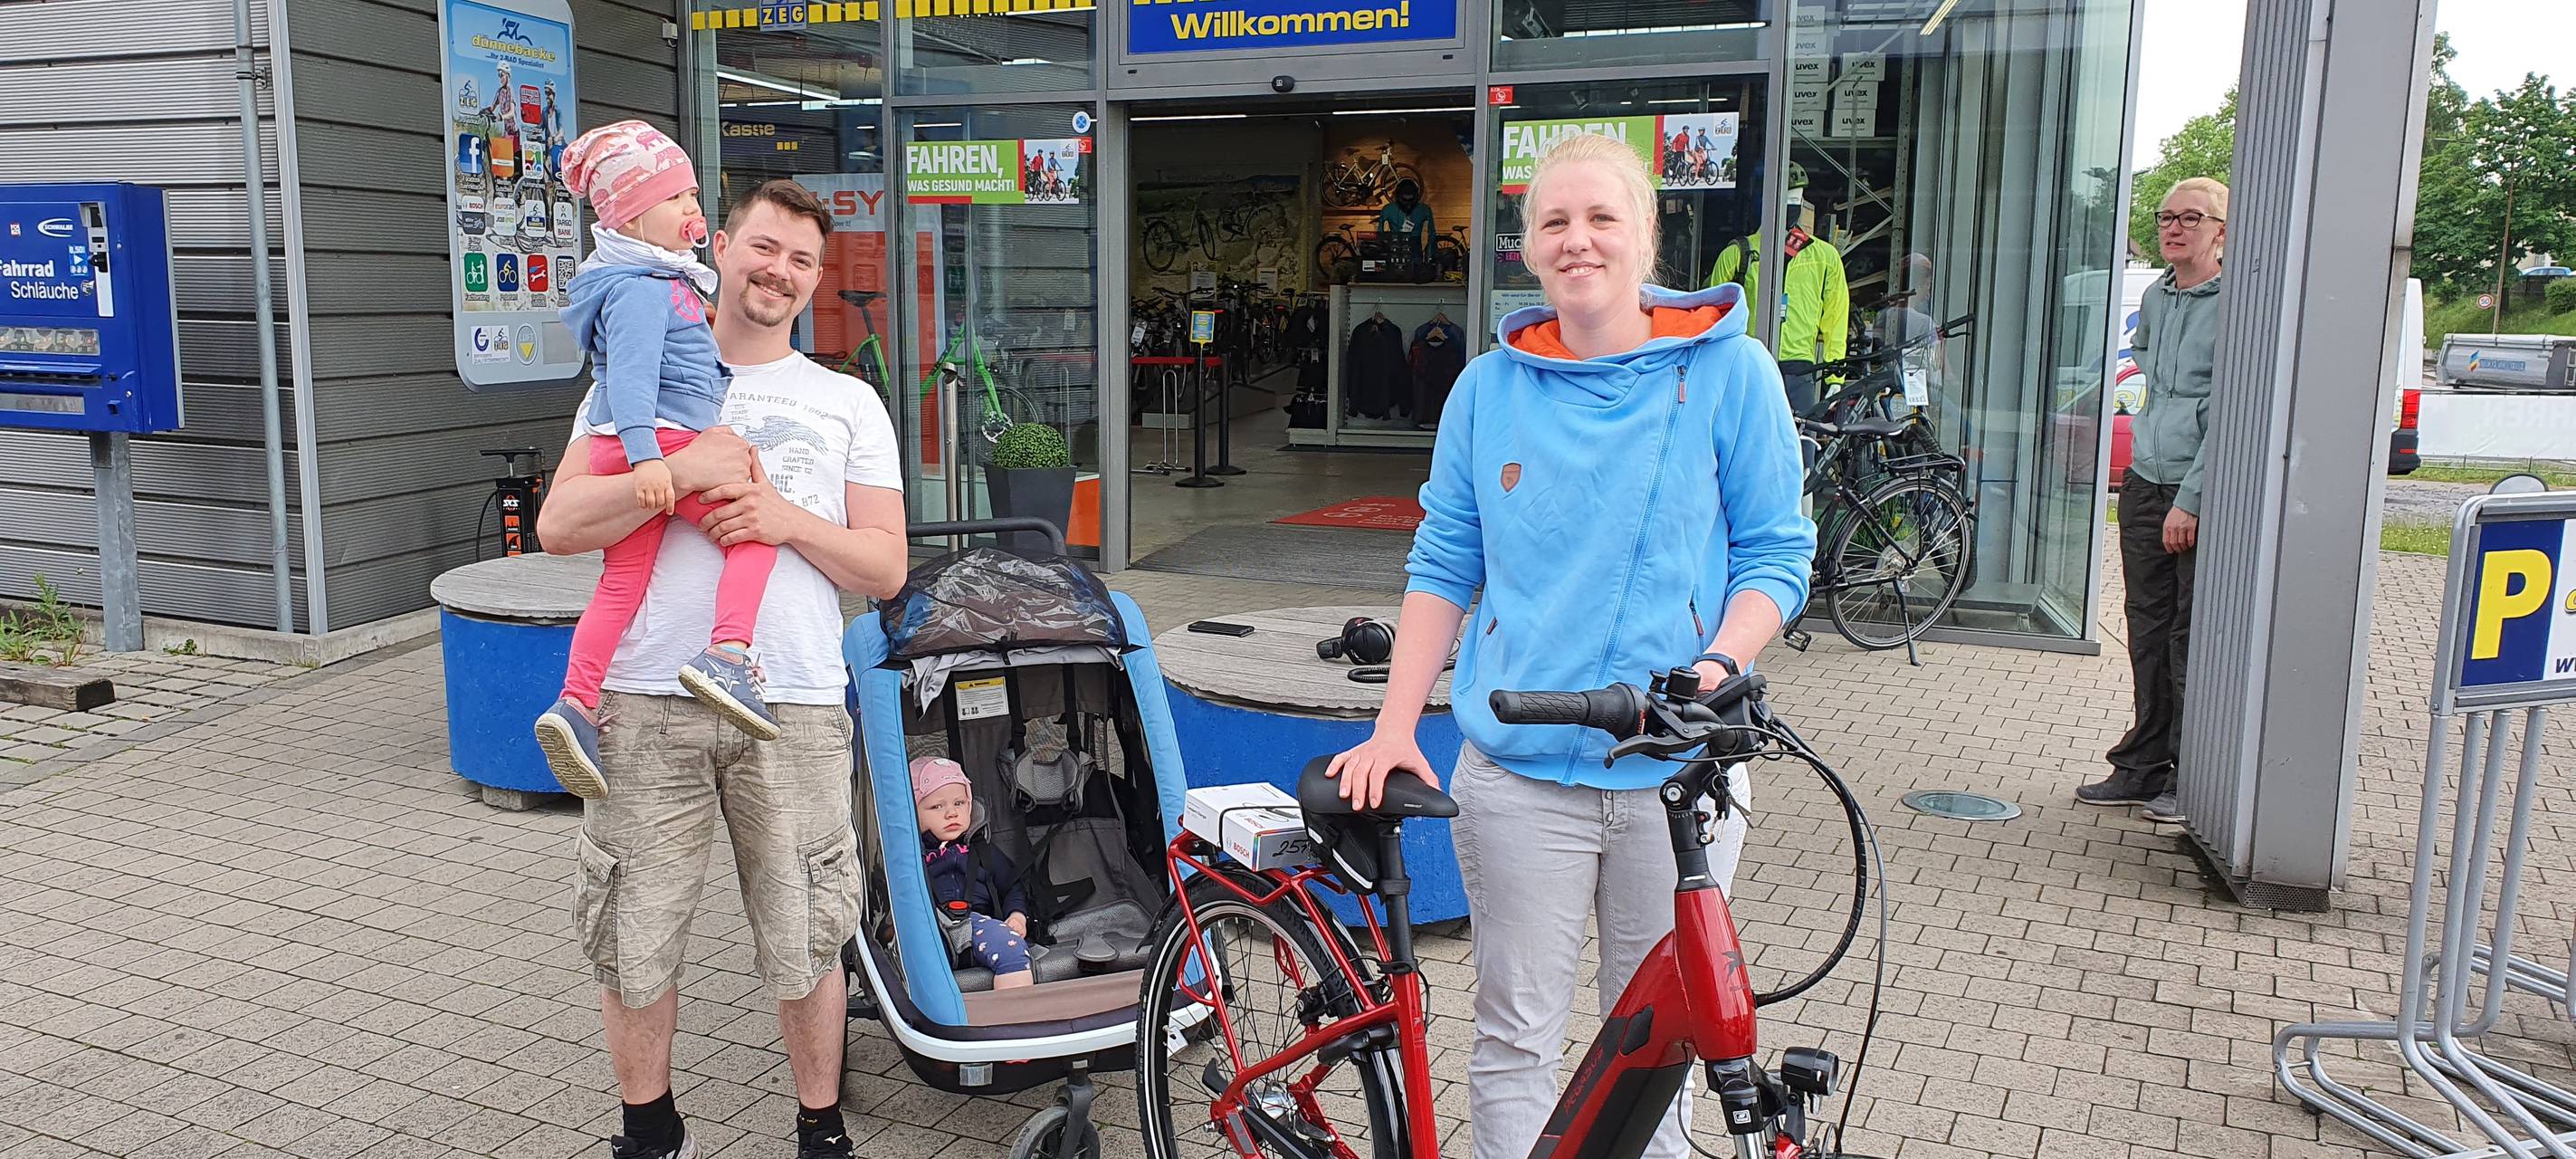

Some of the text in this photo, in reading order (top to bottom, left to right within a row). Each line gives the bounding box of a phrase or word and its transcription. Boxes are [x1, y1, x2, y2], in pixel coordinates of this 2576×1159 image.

[762, 6, 804, 24] ZEG
[1170, 1, 1409, 40] Willkommen!
[472, 34, 557, 62] dünnebacke
[1796, 62, 1819, 71] uvex
[1792, 118, 1814, 126] uvex
[906, 145, 1004, 178] FAHREN,
[1503, 166, 1532, 180] WAS
[908, 179, 1015, 192] WAS GESUND MACHT!
[556, 218, 572, 226] TARGO
[558, 228, 571, 236] BANK
[0, 259, 55, 278] ahrrad
[10, 281, 79, 300] Schläuche
[2481, 297, 2490, 305] 50
[788, 447, 810, 455] HAND
[782, 455, 815, 465] CRAFTED
[781, 465, 803, 473] SINCE
[2471, 550, 2552, 660] P
[1233, 841, 1250, 859] BOSCH
